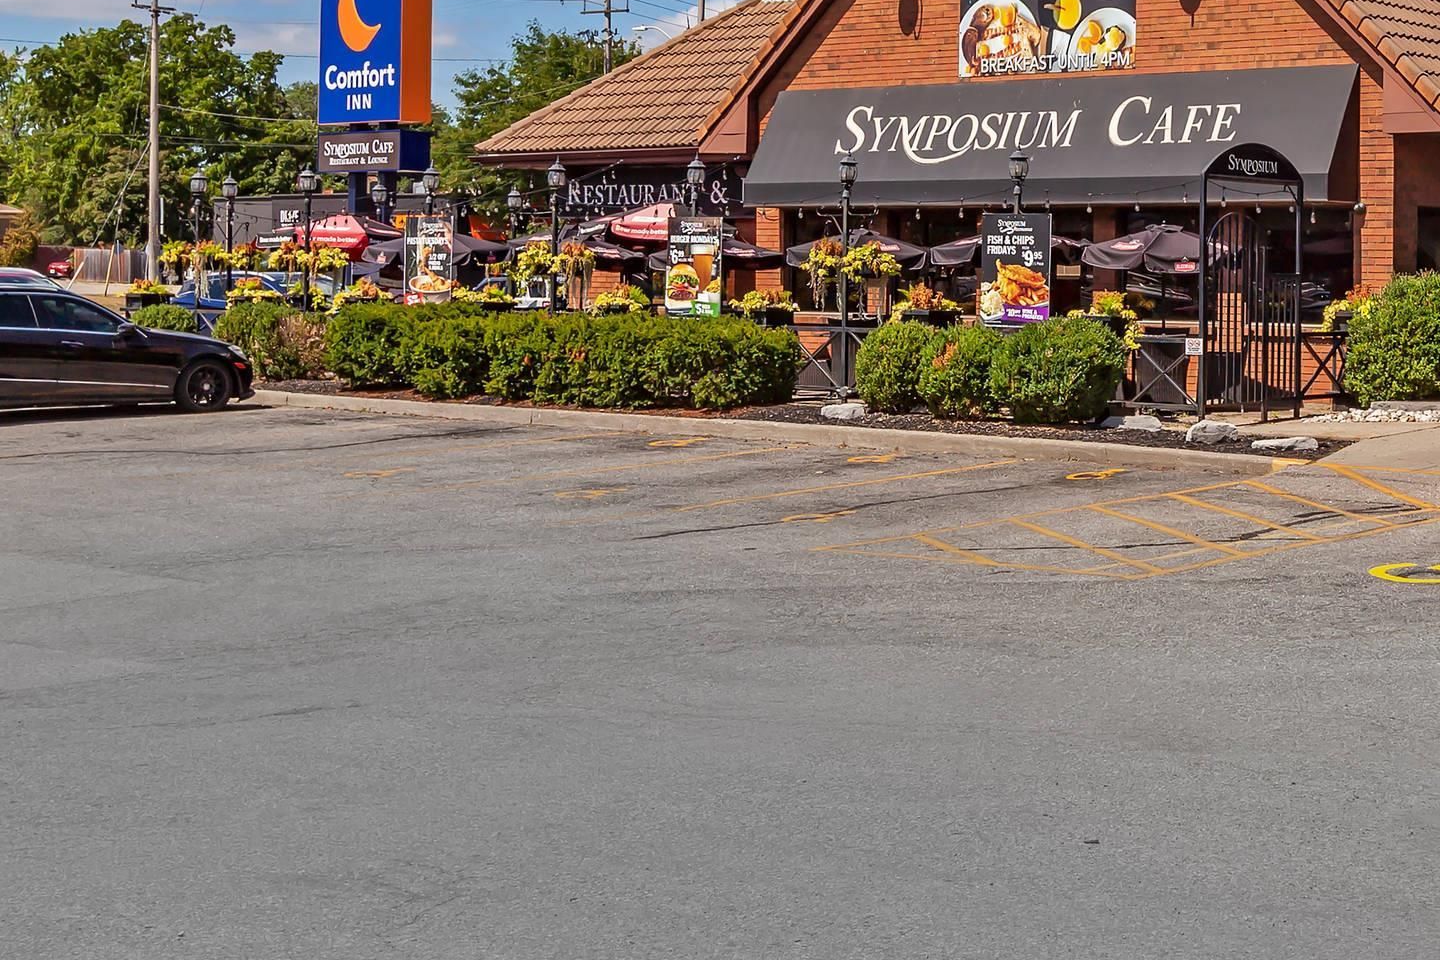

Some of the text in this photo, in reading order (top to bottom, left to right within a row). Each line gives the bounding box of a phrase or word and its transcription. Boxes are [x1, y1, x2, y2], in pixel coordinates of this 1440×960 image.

[980, 50, 1130, 74] BREAKFAST UNTIL 4PM
[325, 61, 395, 90] Comfort
[346, 93, 372, 111] INN
[834, 95, 1241, 164] SYMPOSIUM CAFE
[323, 139, 394, 158] SYMPOSIUM CAFE
[1228, 153, 1278, 176] SYMPOSIUM
[710, 180, 728, 204] &
[987, 235, 1034, 246] FISH & CHIPS
[987, 245, 1016, 255] FRIDAYS
